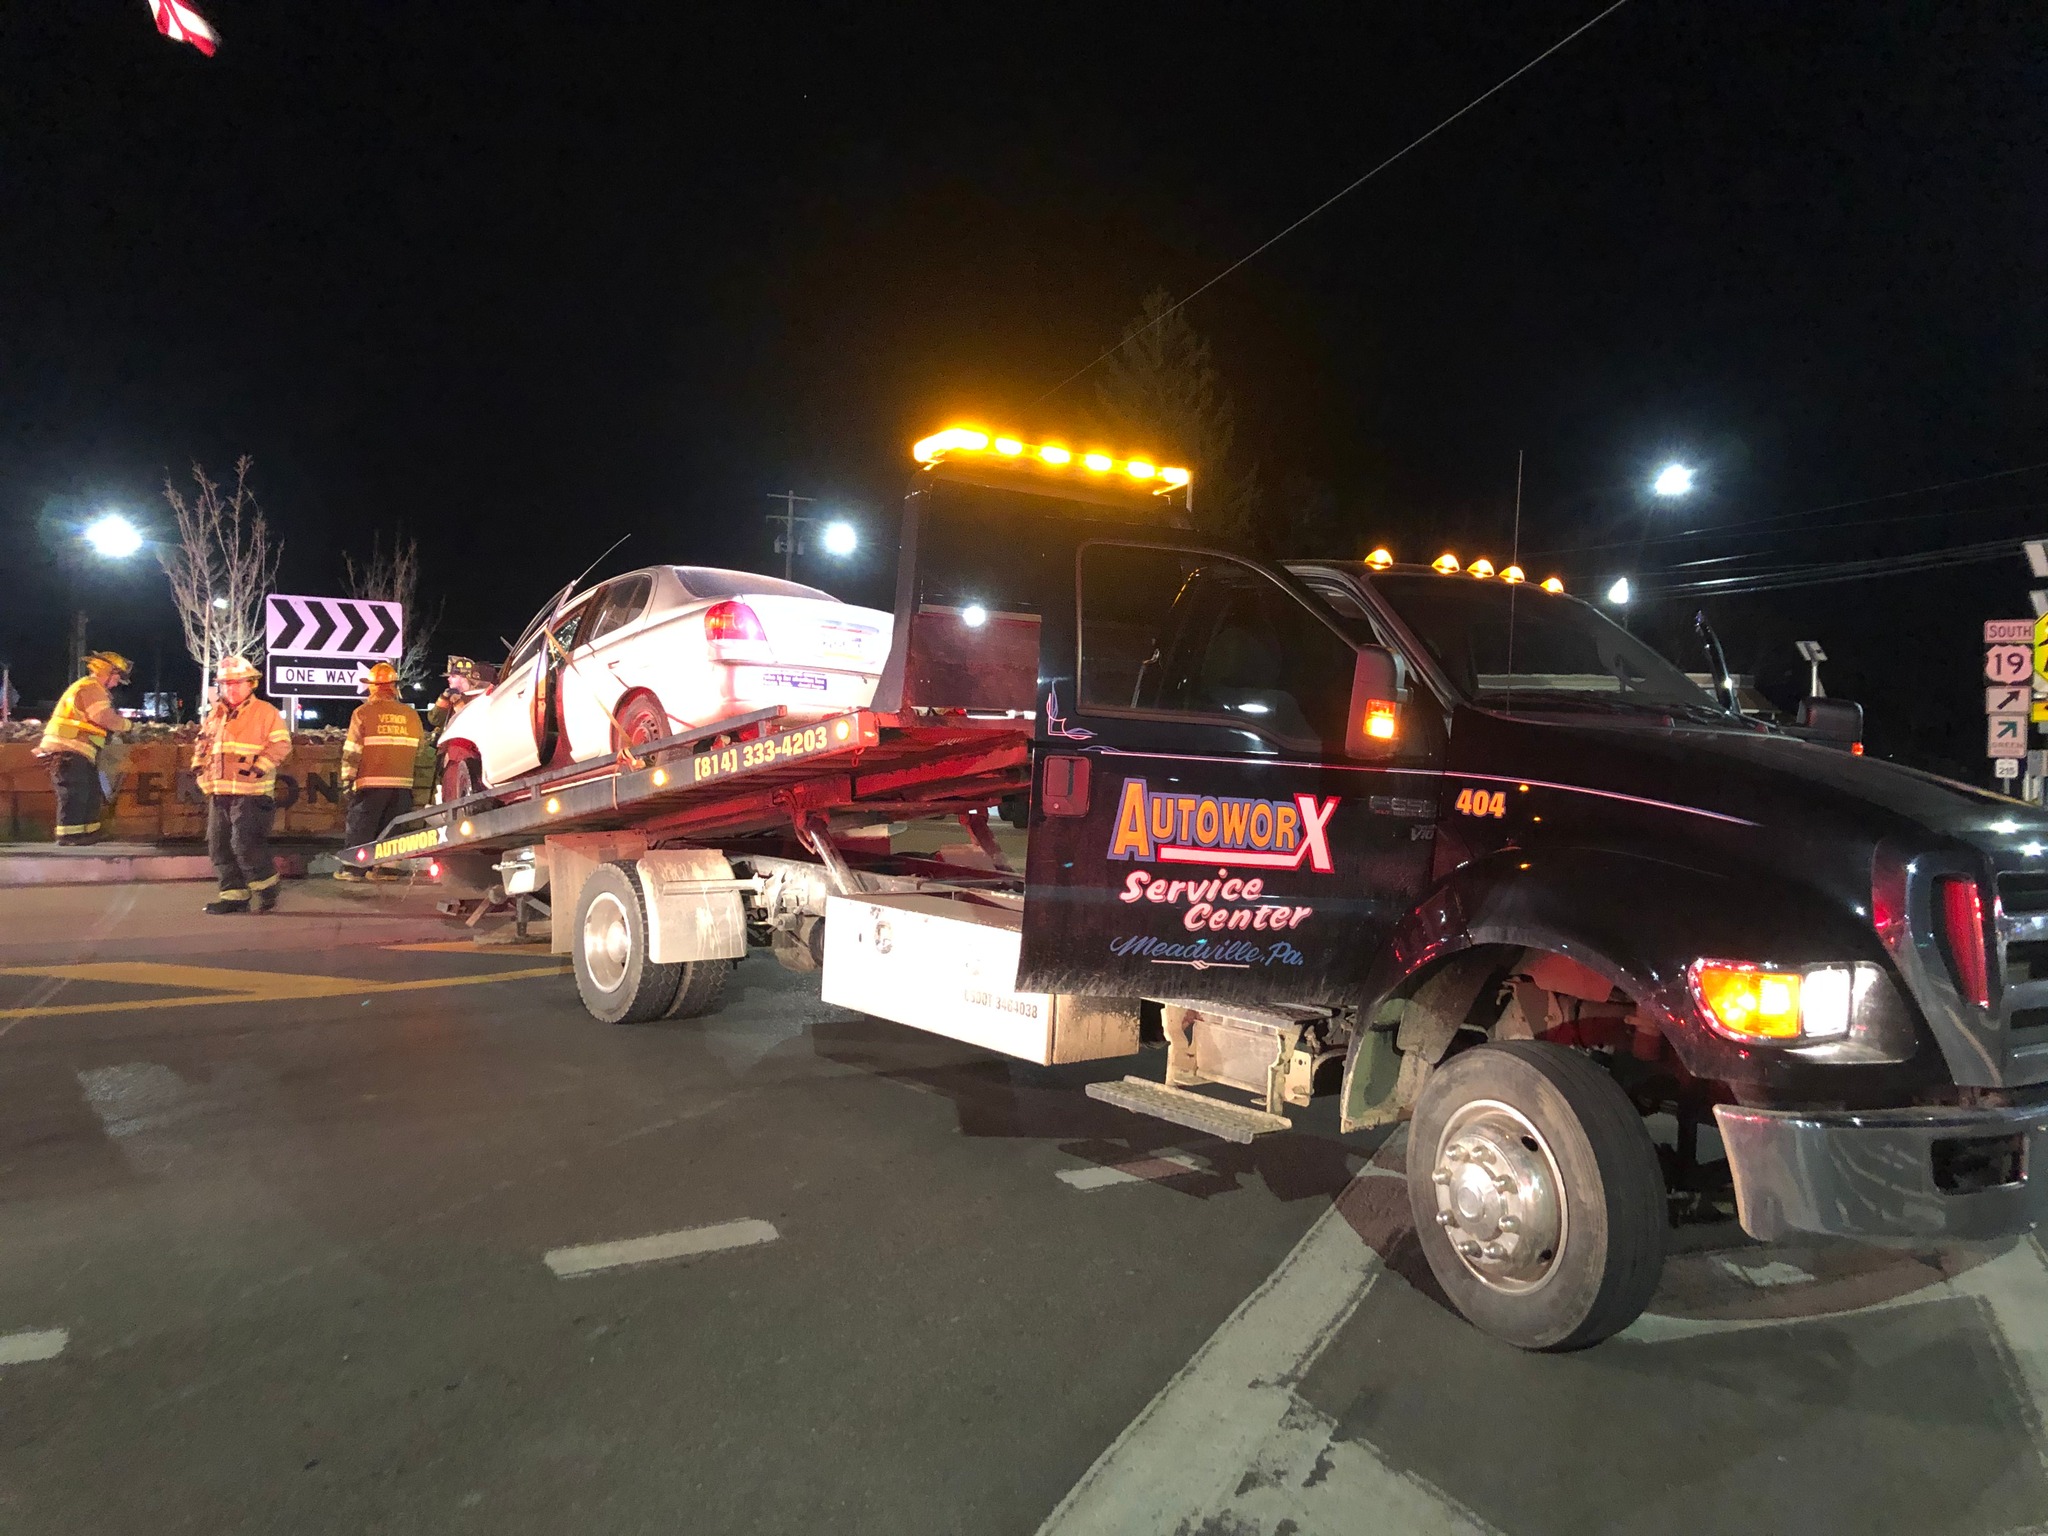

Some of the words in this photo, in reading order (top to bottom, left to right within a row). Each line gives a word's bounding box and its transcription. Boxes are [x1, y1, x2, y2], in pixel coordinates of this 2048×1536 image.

[1988, 624, 2033, 638] SOUTH
[285, 668, 315, 682] ONE
[325, 670, 356, 683] WAY
[1995, 653, 2024, 676] 19
[377, 724, 409, 735] CENTRAL
[694, 748, 738, 781] (814)
[743, 727, 827, 767] 333-4203
[1455, 787, 1507, 818] 404
[1107, 778, 1341, 874] AUTOWORX
[374, 826, 448, 859] AUTOWORX
[1119, 869, 1264, 904] Service
[1183, 902, 1313, 931] Center
